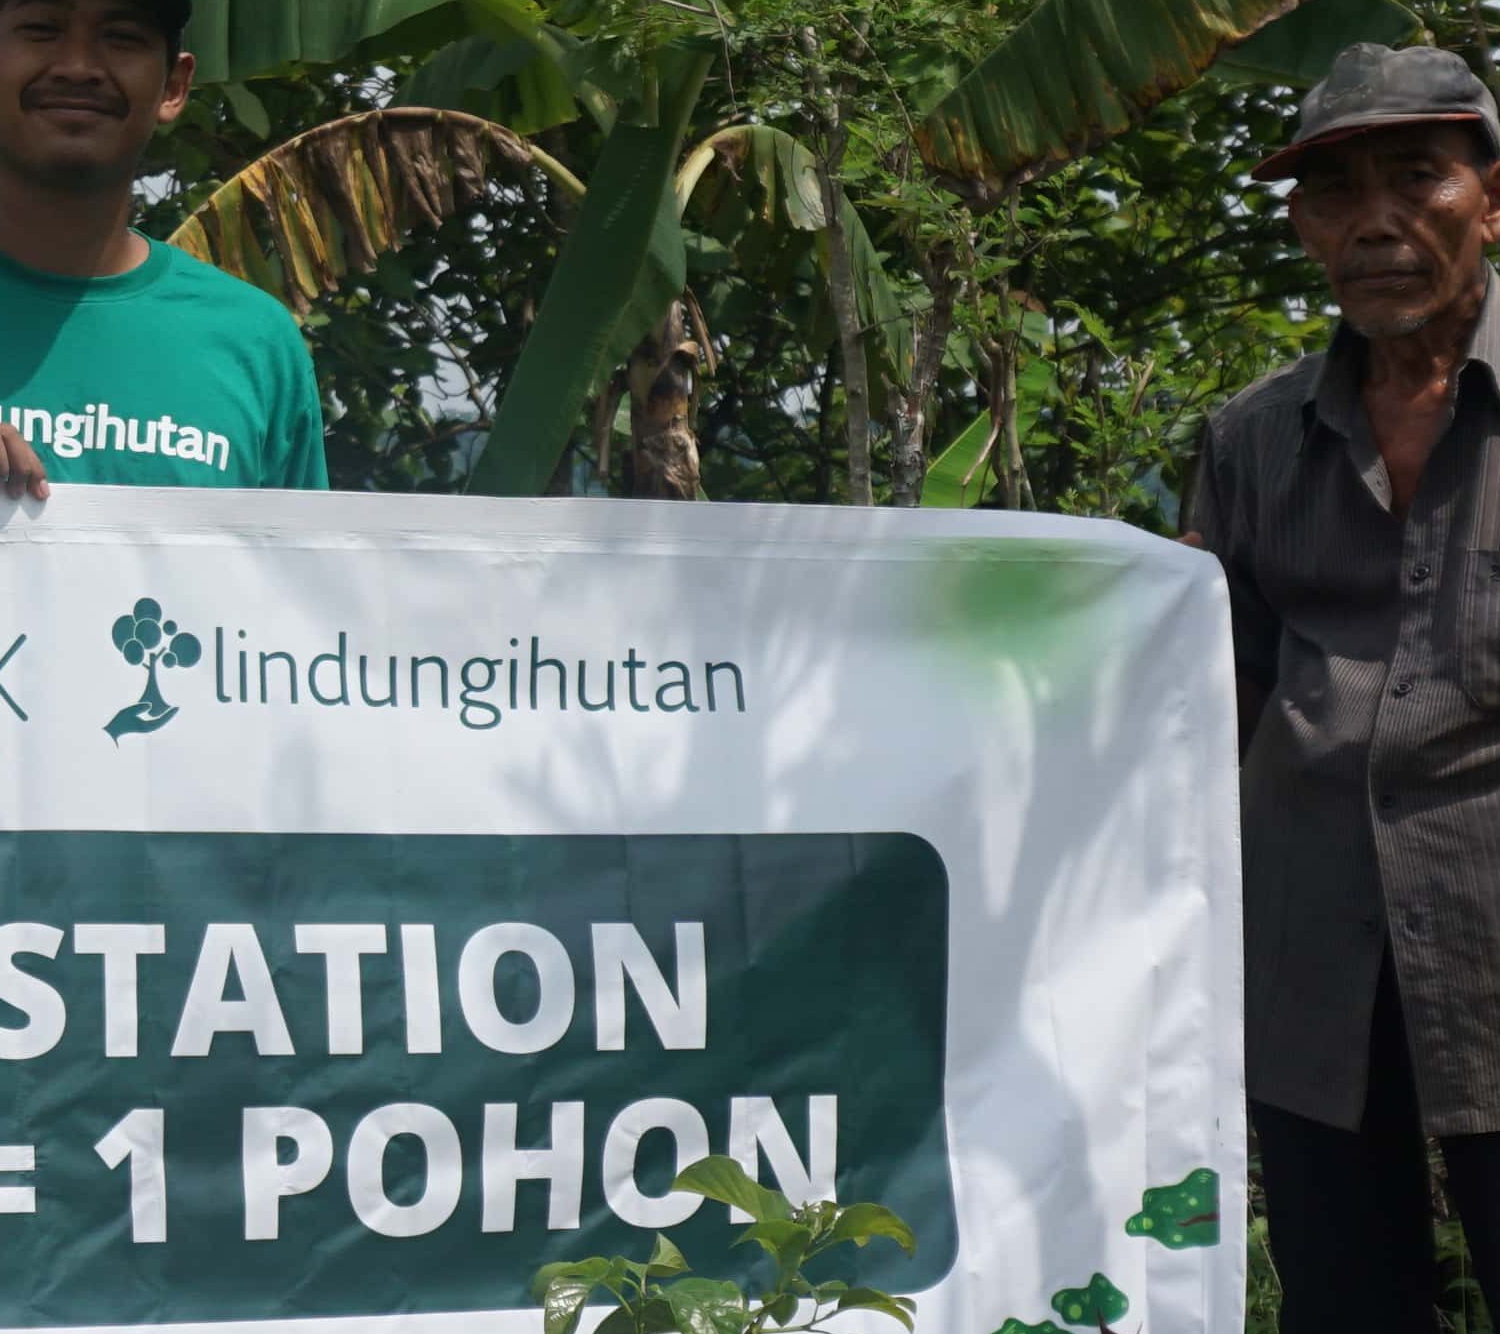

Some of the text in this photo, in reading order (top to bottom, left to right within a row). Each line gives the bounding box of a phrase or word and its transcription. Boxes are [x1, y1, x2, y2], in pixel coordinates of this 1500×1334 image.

[213, 625, 746, 730] lindungihutan
[93, 1108, 166, 1243] 1
[243, 1094, 838, 1240] POHON
